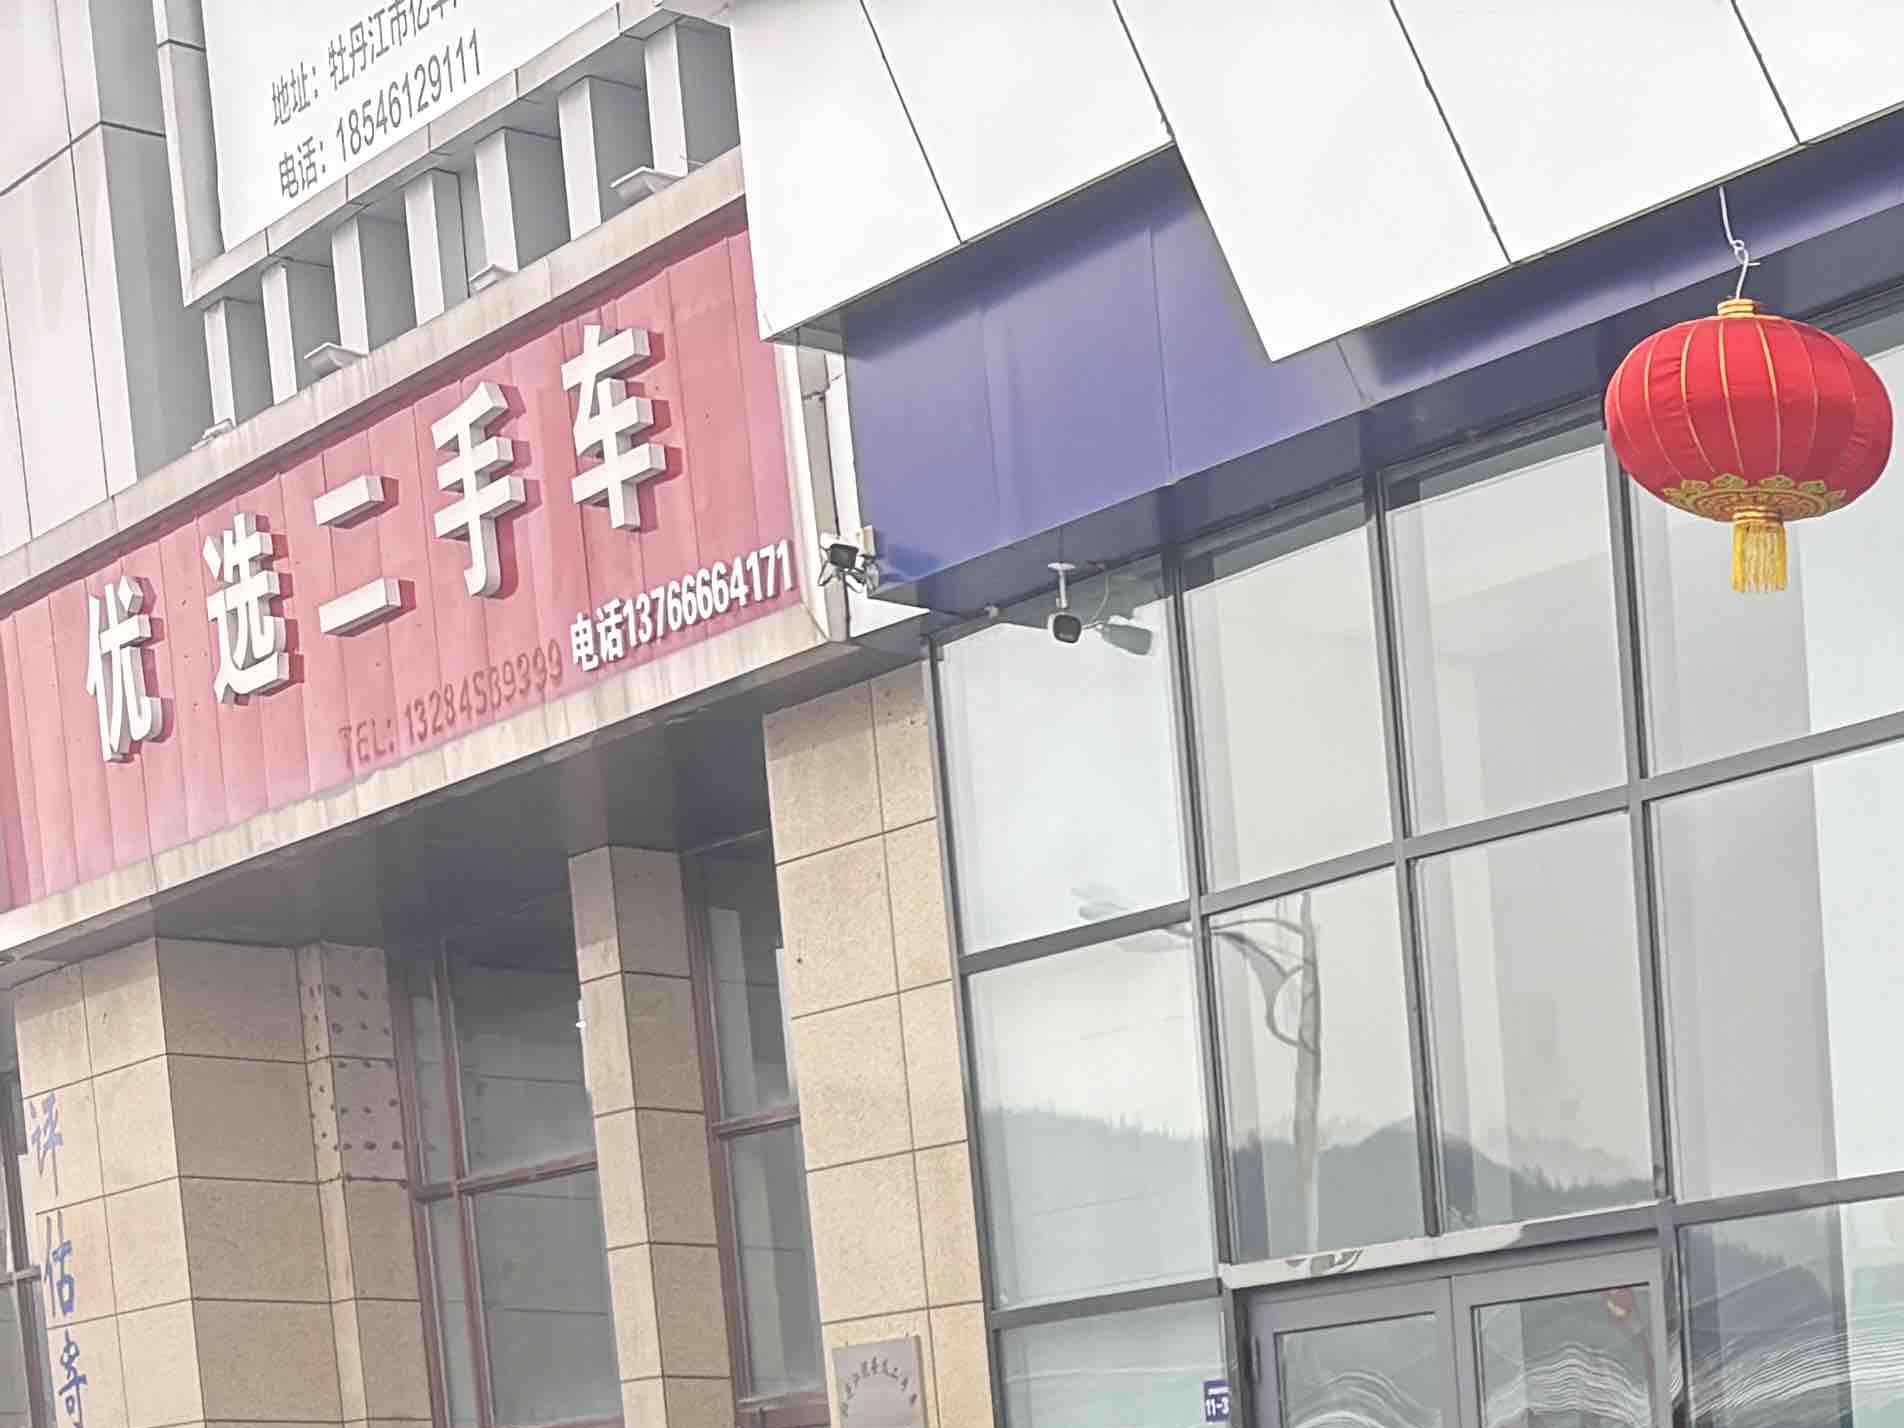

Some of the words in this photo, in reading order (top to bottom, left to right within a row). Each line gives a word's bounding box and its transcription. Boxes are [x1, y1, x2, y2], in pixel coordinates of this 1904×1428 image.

[86, 325, 667, 763] 优选二手车
